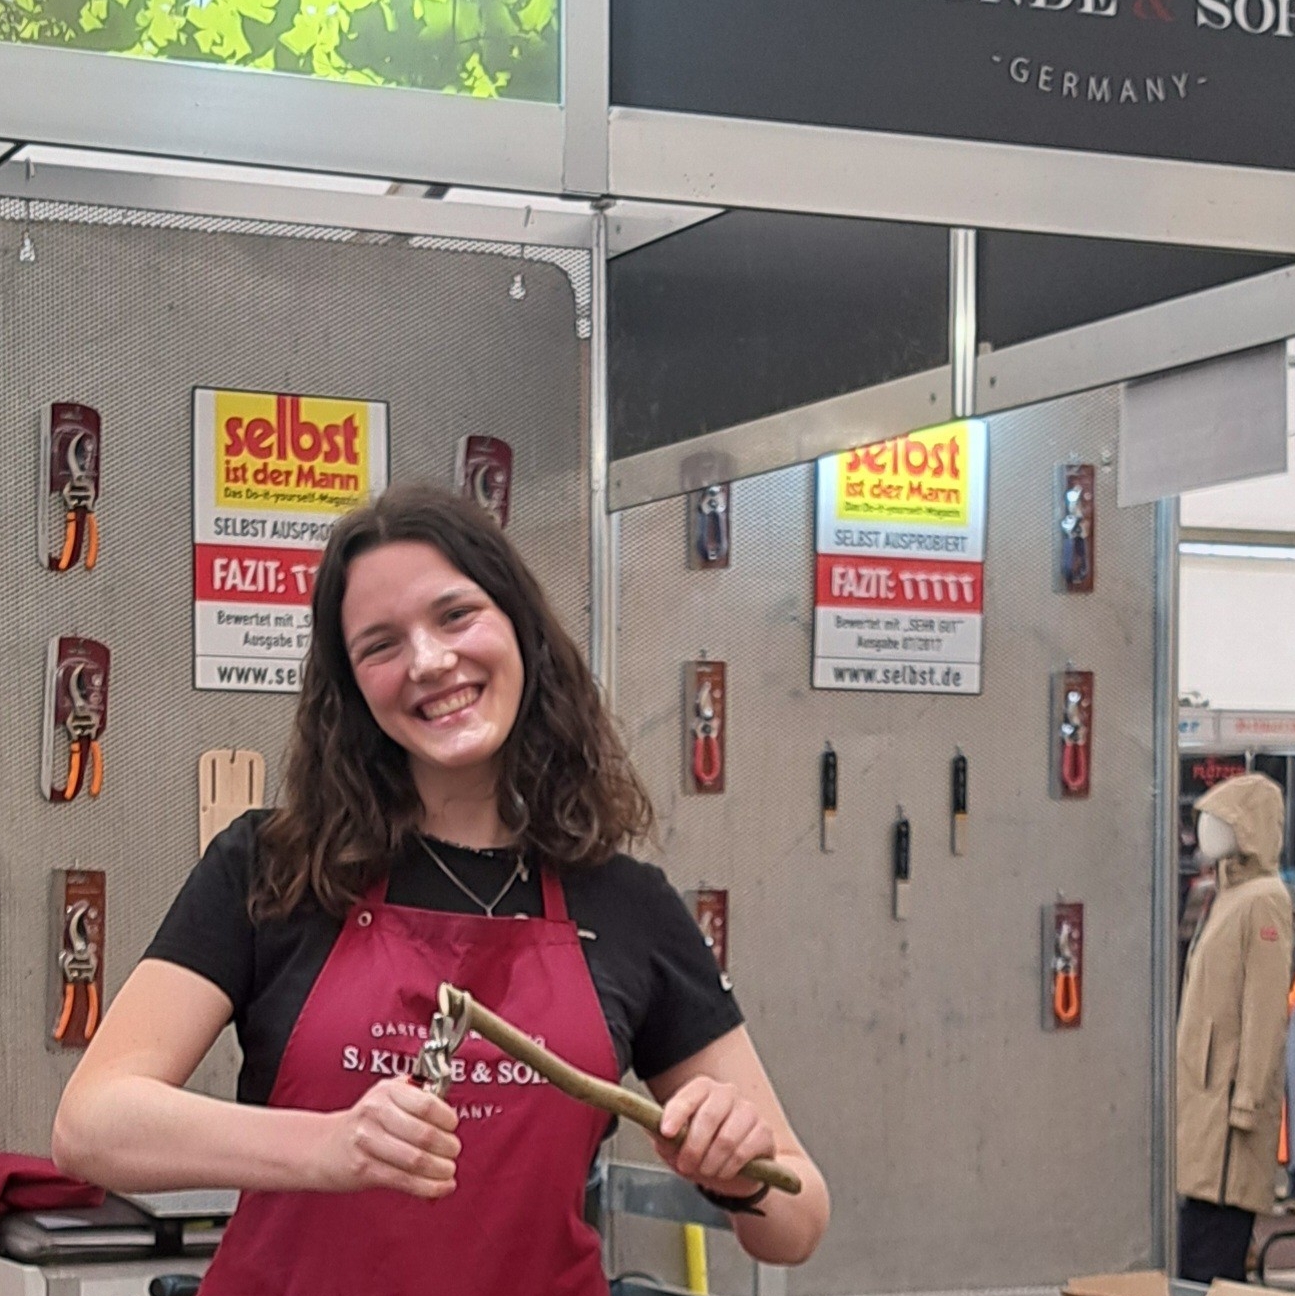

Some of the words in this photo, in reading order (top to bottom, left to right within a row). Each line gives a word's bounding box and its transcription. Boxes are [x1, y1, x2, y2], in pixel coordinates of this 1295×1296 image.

[224, 394, 359, 465] selbst
[224, 460, 248, 485] ist
[253, 462, 293, 487] der
[296, 465, 359, 491] Mann
[214, 516, 268, 538] SELBST
[212, 557, 286, 594] FAZIT:
[216, 610, 271, 627] Bewertet
[274, 614, 294, 628] mit
[243, 631, 293, 650] Ausgabe
[833, 665, 962, 687] www.selbst.de
[471, 1060, 492, 1084] &
